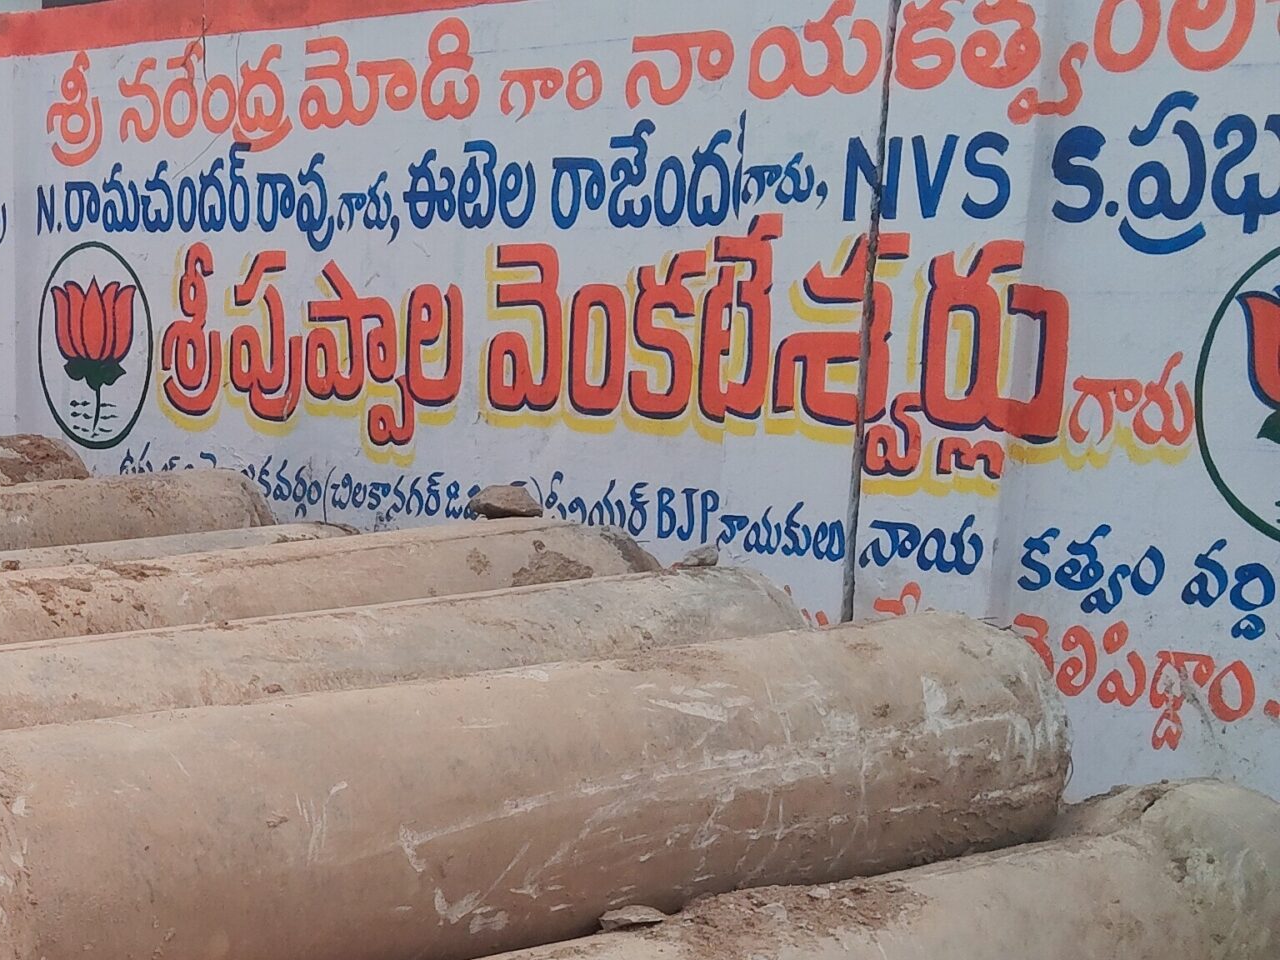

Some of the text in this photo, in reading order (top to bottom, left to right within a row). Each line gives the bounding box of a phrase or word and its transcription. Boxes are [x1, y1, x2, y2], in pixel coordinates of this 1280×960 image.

[47, 50, 102, 166] శ్రీ
[118, 40, 293, 152] నరేంద్ర
[299, 17, 480, 130] మోడి
[500, 59, 602, 122] గారి
[843, 133, 1010, 221] NVS
[1073, 352, 1195, 446] గారు
[656, 487, 720, 544] BJP
